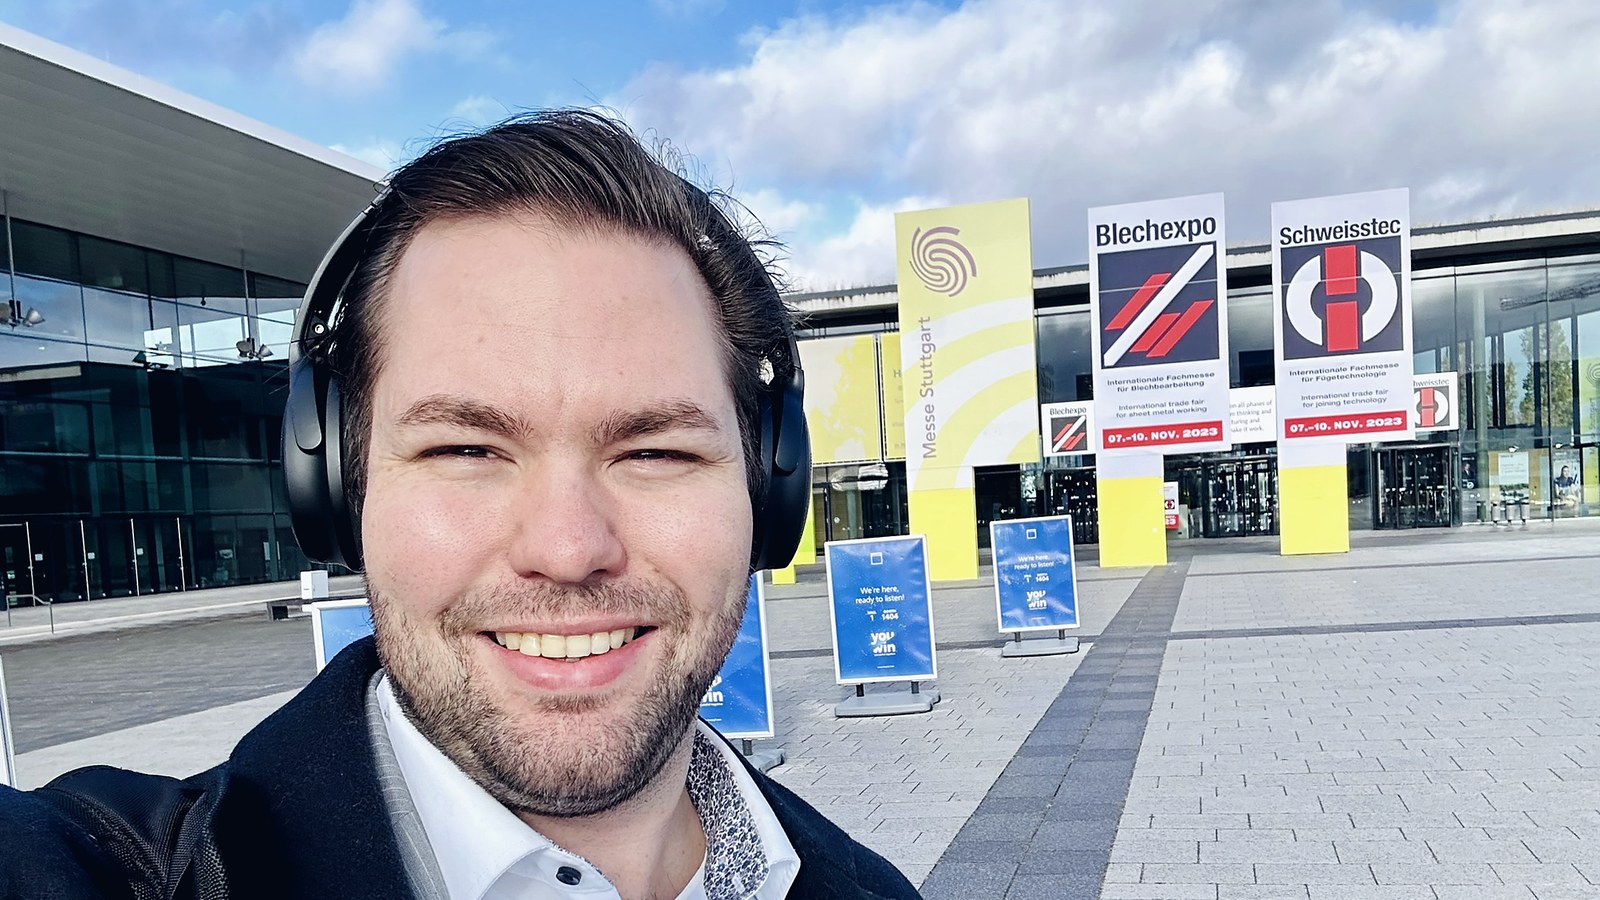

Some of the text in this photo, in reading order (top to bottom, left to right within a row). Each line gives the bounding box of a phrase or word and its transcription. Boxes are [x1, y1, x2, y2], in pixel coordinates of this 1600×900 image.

[1096, 217, 1216, 246] Blechexpo
[1280, 218, 1401, 245] Schweisstec
[1289, 363, 1400, 376] Internationale Fachmesse
[1107, 371, 1215, 386] Internationale Fachmesse
[1315, 371, 1387, 382] Fügetechnologie
[918, 316, 937, 458] Messe Stuttgart
[1131, 380, 1205, 391] Blechbearbeitung
[1413, 379, 1450, 387] hweisstec
[1301, 391, 1350, 401] International
[1119, 402, 1167, 411] International
[1168, 400, 1190, 408] trade
[1315, 399, 1341, 408] joining
[1343, 397, 1388, 406] technology
[1049, 407, 1087, 415] Blechexpo
[1176, 406, 1208, 415] working
[1334, 420, 1363, 430] NOV.
[1366, 417, 1403, 427] 2023
[1151, 430, 1180, 441] NOV.
[1182, 428, 1218, 438] 2023
[860, 585, 899, 594] We're here,
[855, 595, 875, 605] ready
[884, 594, 905, 602] listen!
[1026, 590, 1046, 602] you
[1028, 599, 1047, 608] win
[881, 613, 899, 621] 1404
[870, 631, 895, 645] you
[873, 643, 896, 653] win
